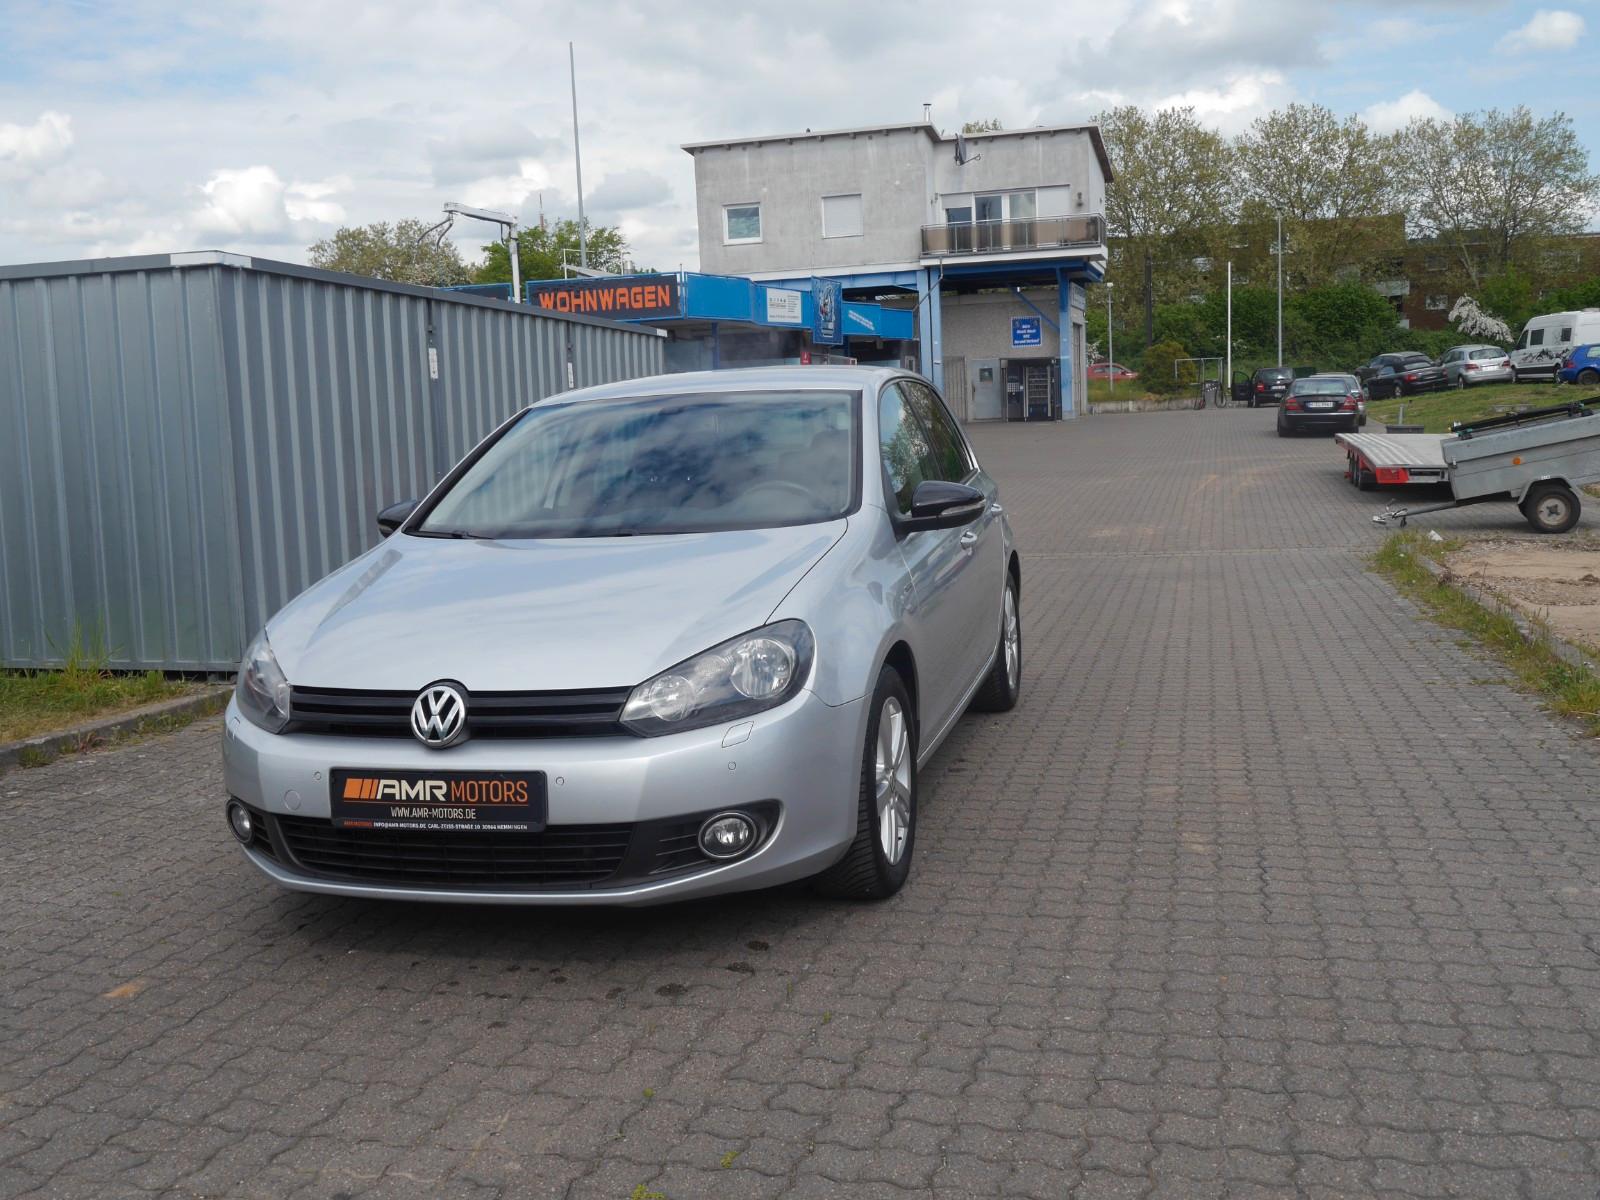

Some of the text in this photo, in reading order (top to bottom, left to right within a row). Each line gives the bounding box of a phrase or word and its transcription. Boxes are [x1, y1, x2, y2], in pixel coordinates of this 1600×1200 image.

[539, 285, 670, 312] WOHNWAGEN
[411, 686, 465, 743] VW
[376, 779, 528, 803] AMR MOTORS
[390, 807, 477, 819] WWW.AMR-MOTORS.DE
